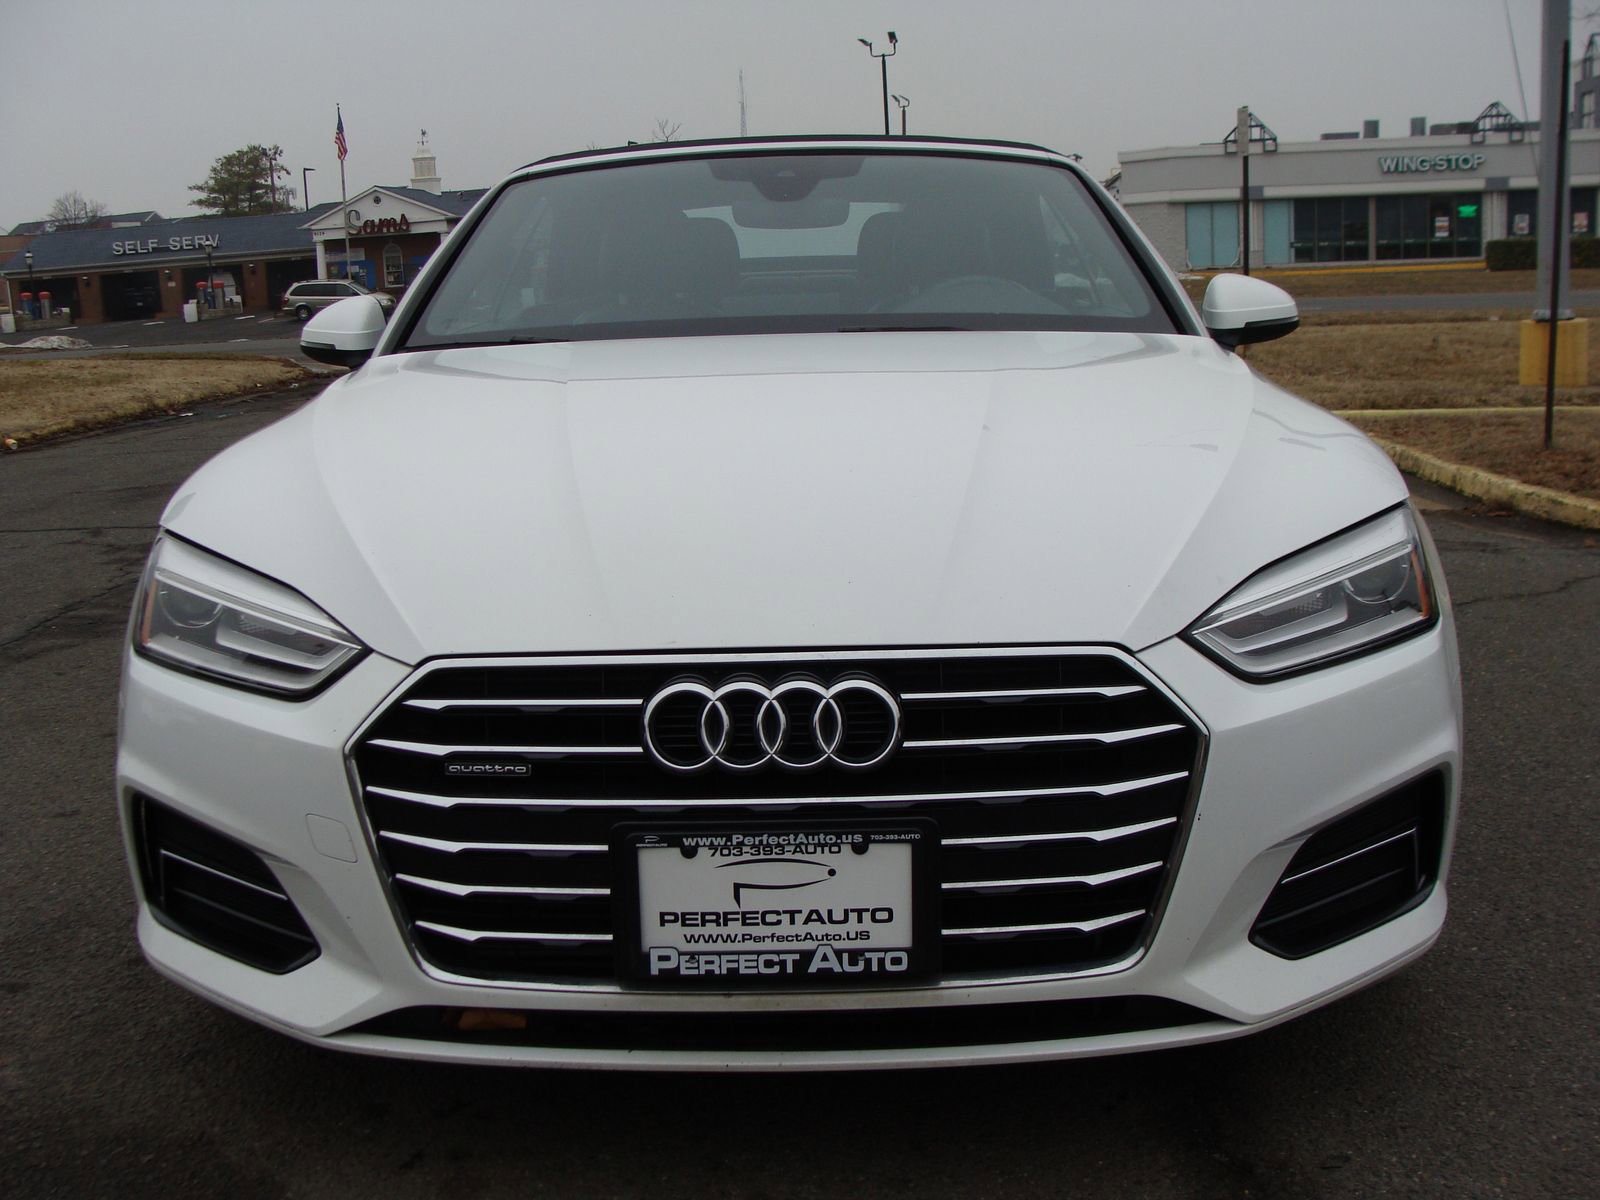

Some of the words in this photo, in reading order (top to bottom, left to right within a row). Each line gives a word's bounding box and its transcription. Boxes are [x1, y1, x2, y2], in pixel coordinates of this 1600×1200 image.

[112, 239, 159, 255] SELF
[168, 233, 219, 251] SERV
[448, 764, 527, 774] quattro
[682, 833, 863, 846] www.PerfectAuto.us
[707, 844, 842, 857] 703-393-AUTO
[659, 907, 894, 927] PERFECTAUTO
[683, 930, 871, 944] WWW.PerfectAuto.US
[649, 947, 800, 976] PERFECT
[807, 944, 909, 973] AUTO
